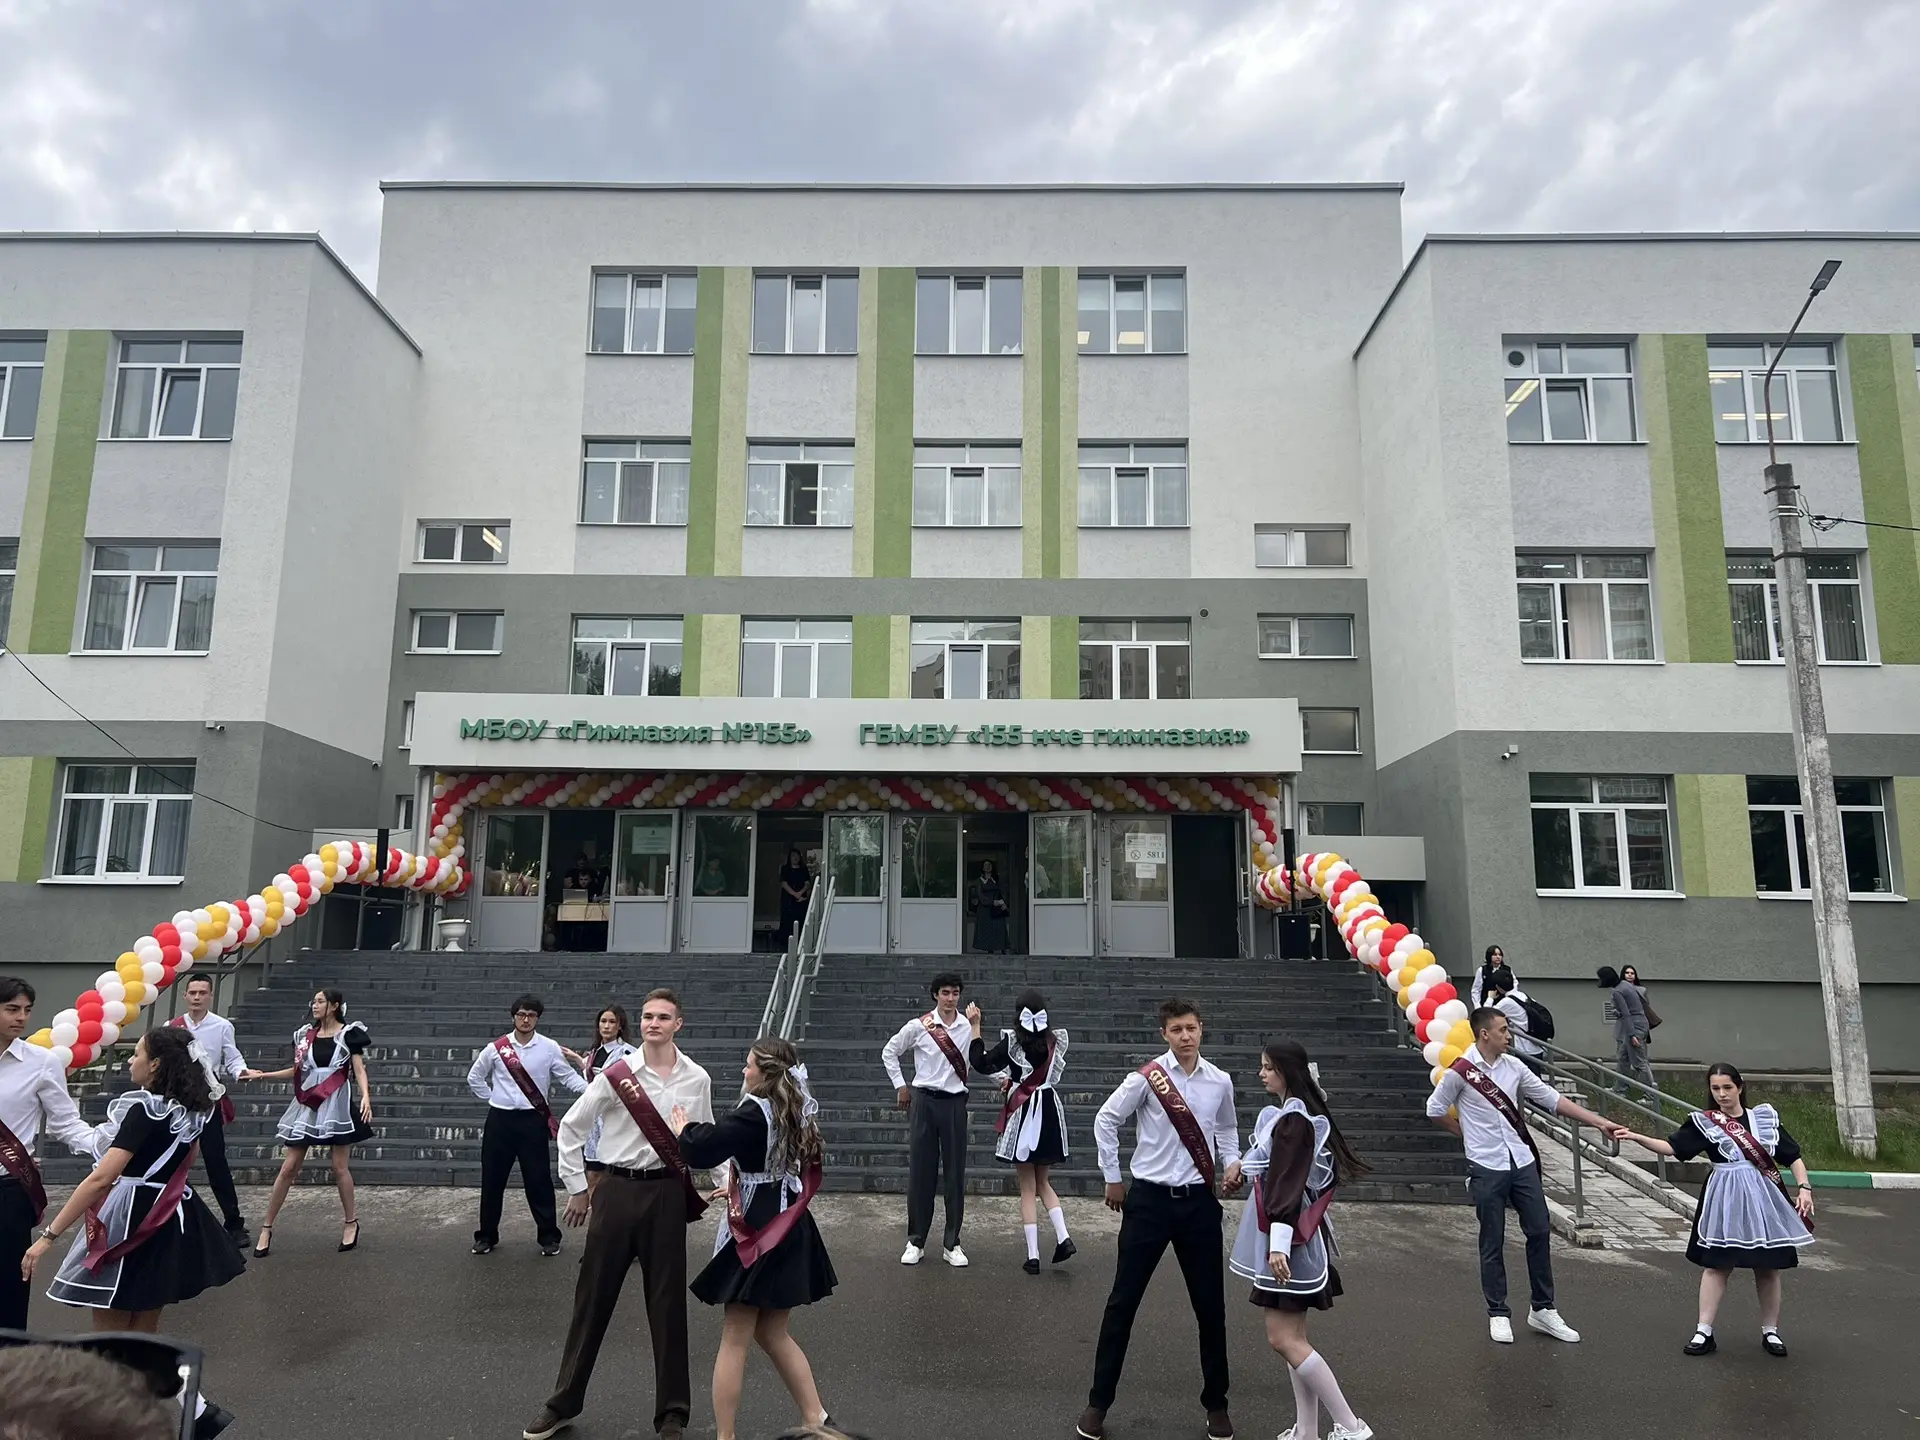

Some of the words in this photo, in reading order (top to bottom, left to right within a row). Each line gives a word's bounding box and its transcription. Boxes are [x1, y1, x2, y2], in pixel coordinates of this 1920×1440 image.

[459, 717, 547, 741] МБОУ
[556, 719, 712, 744] «Гимназия
[721, 721, 813, 744] №155»
[858, 722, 957, 745] ГБМБУ
[967, 723, 1023, 745] «155
[1031, 727, 1084, 746] нче
[1093, 727, 1252, 747] гимназия»
